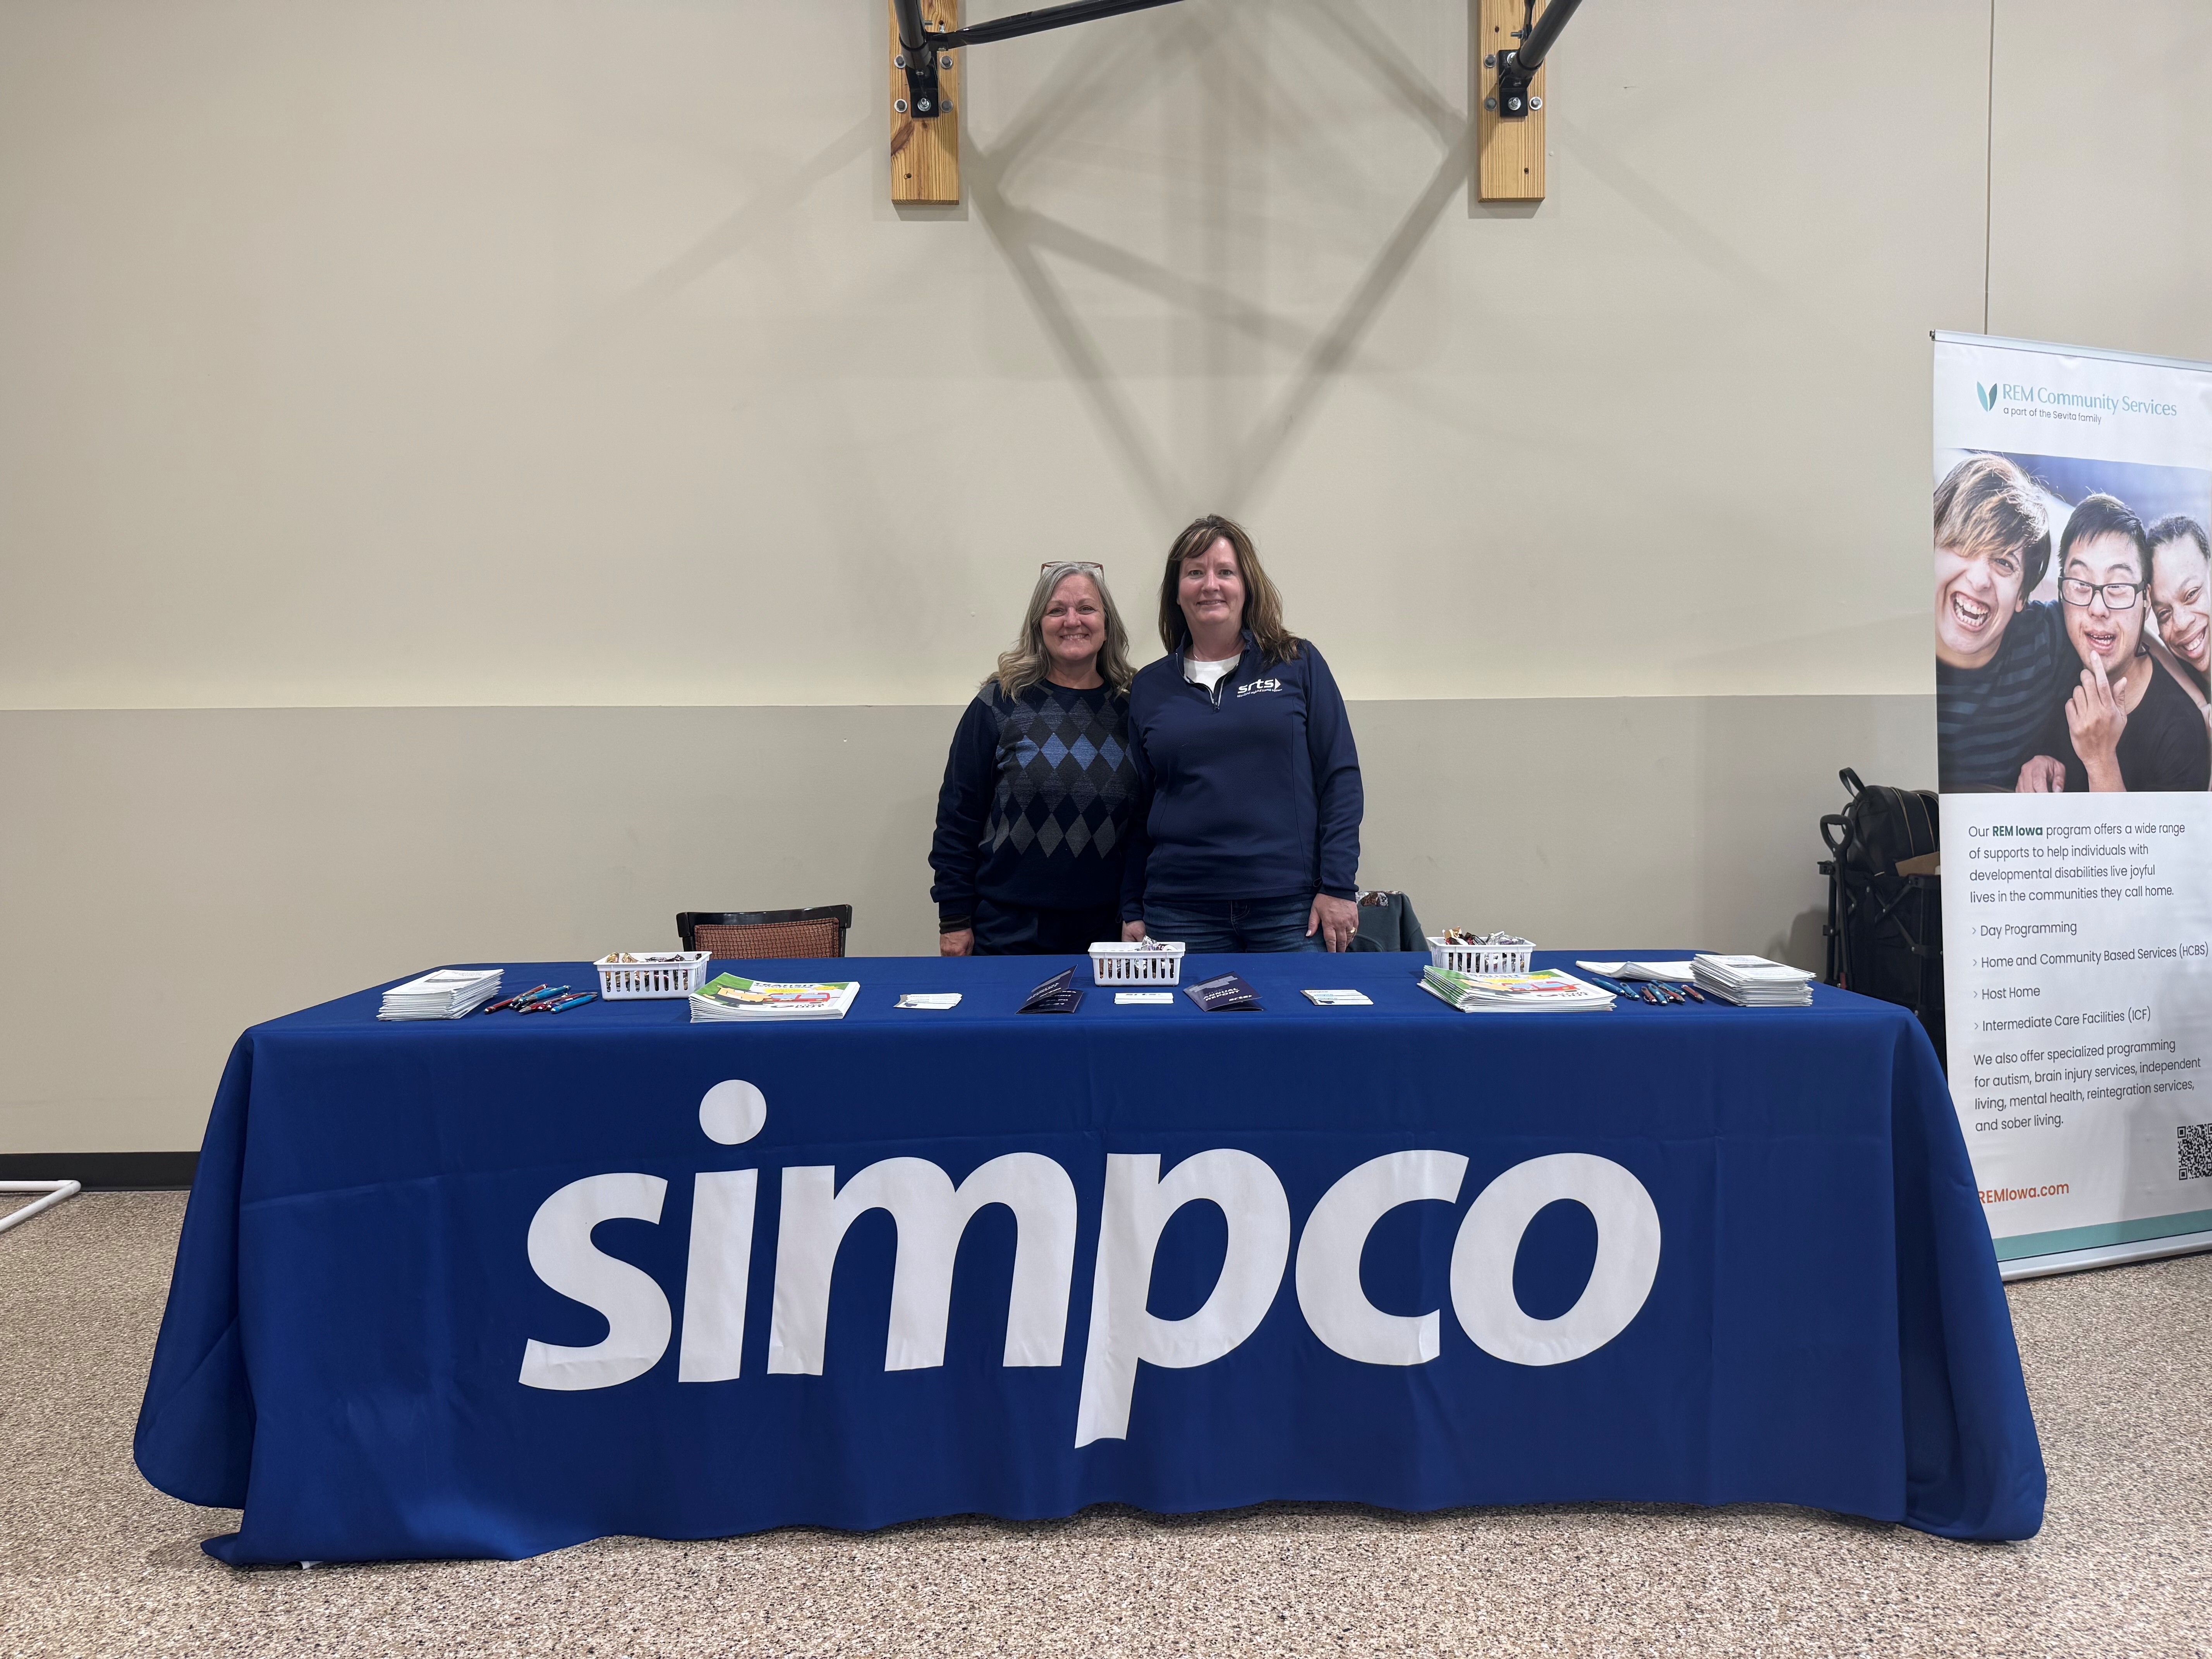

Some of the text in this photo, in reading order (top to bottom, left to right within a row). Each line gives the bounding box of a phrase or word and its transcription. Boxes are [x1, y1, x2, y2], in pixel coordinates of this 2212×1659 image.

[2003, 384, 2176, 416] REM Community Services
[2011, 409, 2027, 417] part
[2053, 411, 2076, 420] Sevita
[2078, 413, 2101, 425] family
[1238, 679, 1274, 694] srts
[1969, 823, 2185, 839] Our REM Iowa program offers a wide range
[1969, 844, 2148, 862] of supports to help individuals with
[1970, 864, 2155, 883] developmental disabilities live joyful
[1971, 886, 2173, 903] lives in the communities they call home.
[1981, 921, 2076, 939] Day Programming
[1982, 941, 2208, 968] Home and Community Based Services (HCBS)
[1203, 988, 1240, 999] ANNUAL
[1982, 987, 2040, 1000] Host Home
[1983, 1006, 2150, 1031] Intermediate Care Facilities (ICF)
[1974, 1039, 2175, 1065] We also offer specialized programming
[1975, 1058, 2200, 1087] for autism, brain injury services, independent
[1975, 1080, 2194, 1111] living, mental health, reintegration services,
[1976, 1114, 2063, 1131] and sober living.
[1978, 1183, 2069, 1204] REMIowa.com
[519, 1080, 1661, 1448] simpco
